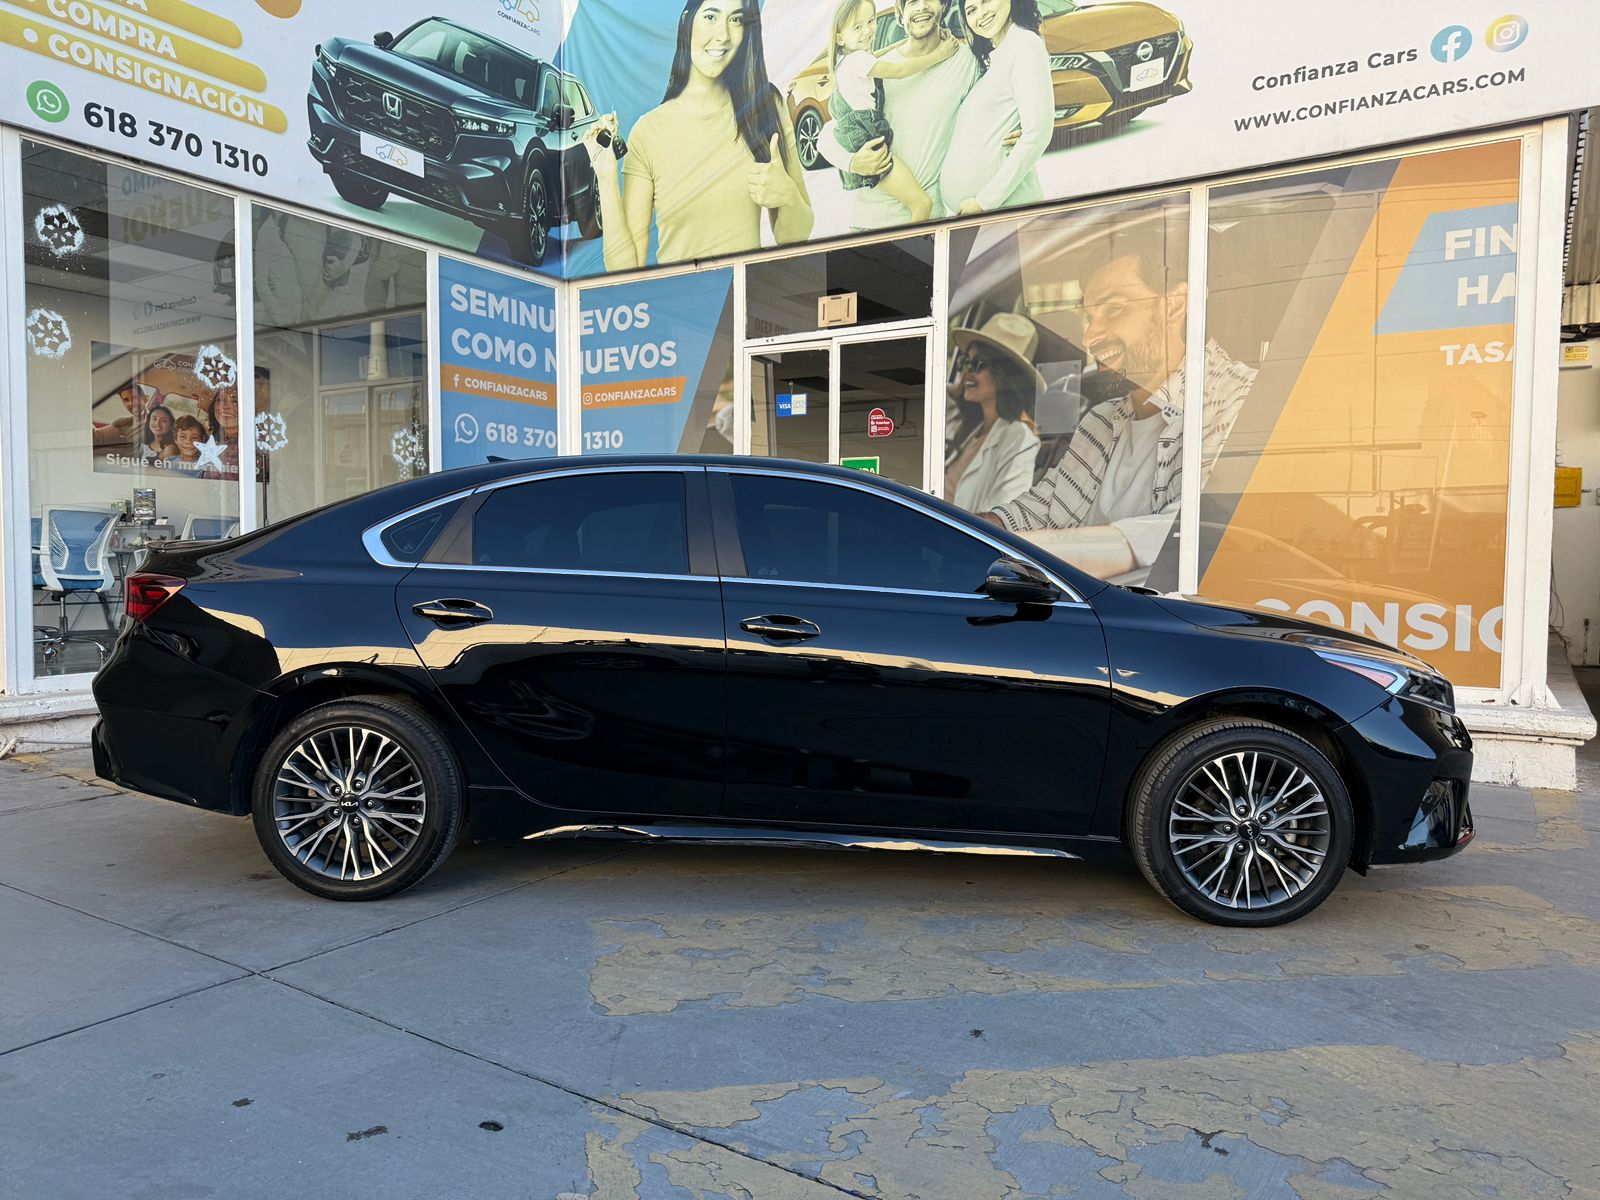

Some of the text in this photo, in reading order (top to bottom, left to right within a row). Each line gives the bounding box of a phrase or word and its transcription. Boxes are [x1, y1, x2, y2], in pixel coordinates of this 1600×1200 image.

[46, 0, 177, 59] COMPRA
[48, 33, 264, 125] CONSIGNACIÓN
[1251, 46, 1418, 92] Confianza Cars
[1233, 67, 1526, 132] WWW.CONFIANZACARS.COM
[83, 101, 269, 177] 618 370 1310
[1445, 222, 1518, 261] FIN
[451, 328, 537, 369] COMO
[464, 377, 548, 401] CONFIANZACARS
[594, 386, 677, 403] CONFIANZACARS
[485, 422, 624, 449] 618 370 1310
[105, 453, 150, 469] Sigue
[153, 457, 172, 469] en
